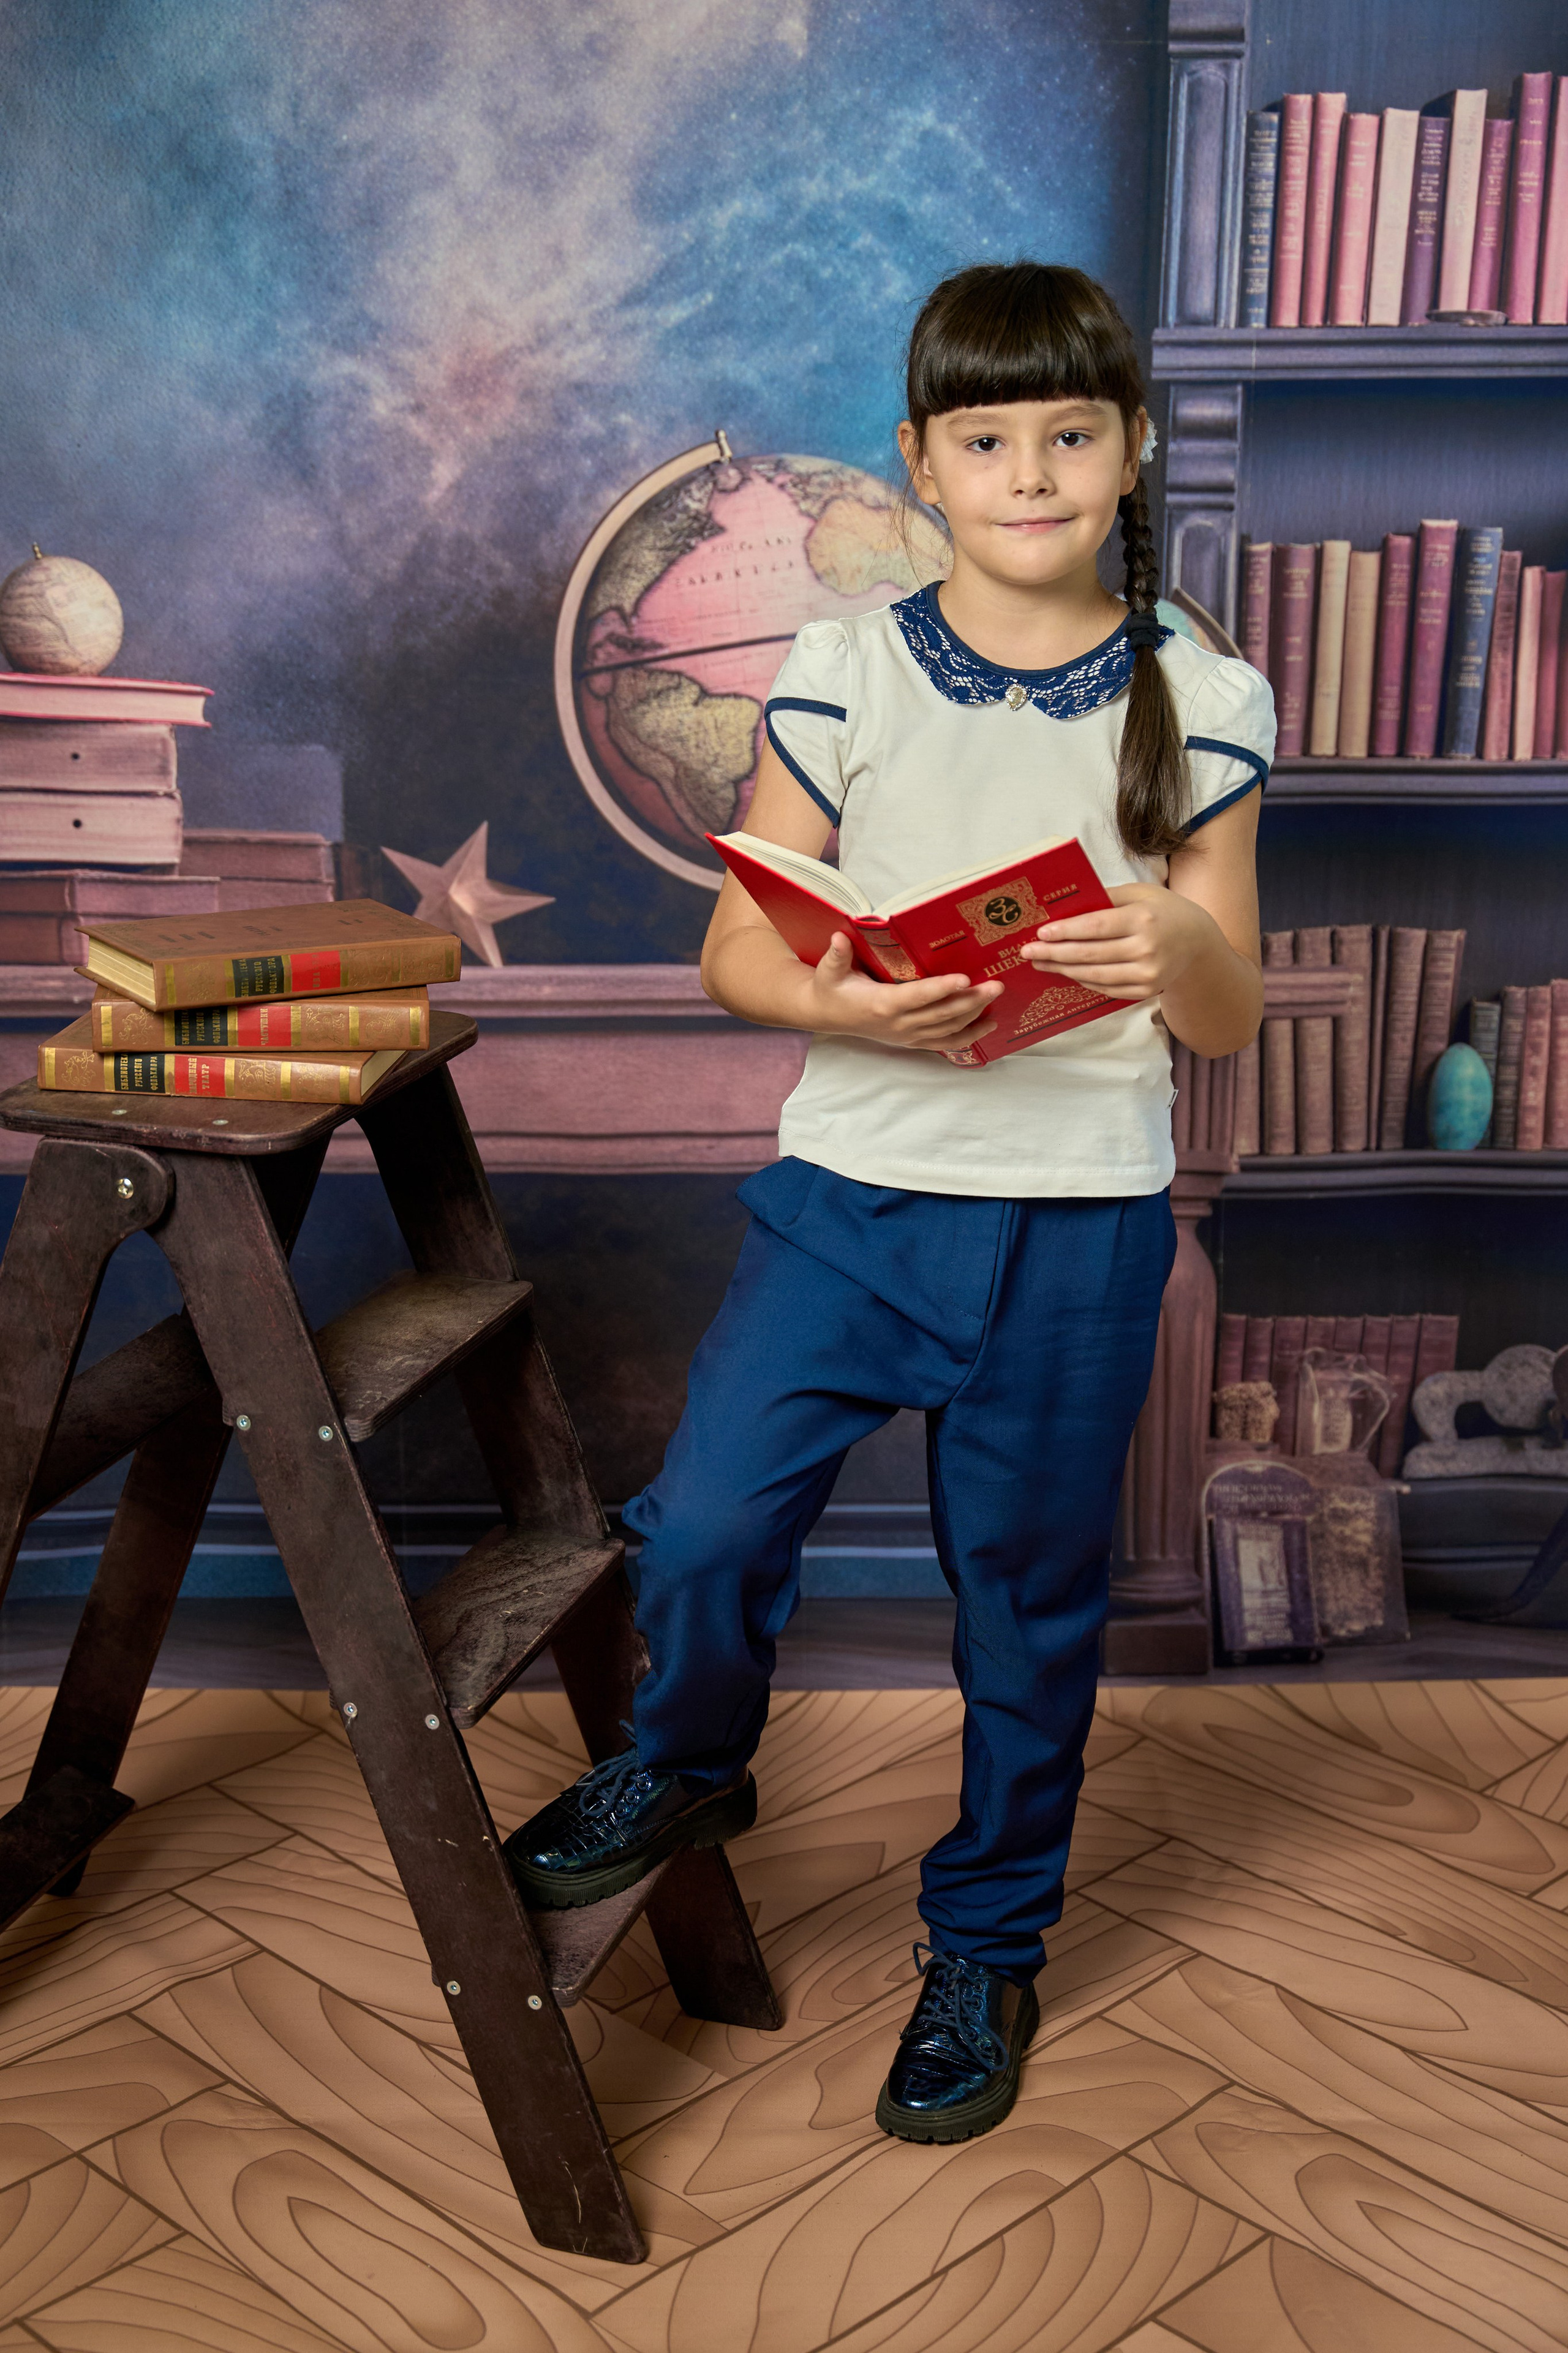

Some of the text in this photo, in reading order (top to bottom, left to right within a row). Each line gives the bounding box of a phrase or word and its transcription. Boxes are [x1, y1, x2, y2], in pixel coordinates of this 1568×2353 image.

[1042, 883, 1078, 901] СЕРИЯ
[928, 930, 965, 949] ЗОЛОТАЯ
[254, 961, 264, 992] РУССКОГО
[196, 1012, 205, 1041] РУССКОГО
[212, 1009, 221, 1044] ФОЛЬКЛОРА
[1014, 995, 1109, 1035] Зарубежная литератур
[134, 1058, 143, 1087] РУССКОГО
[150, 1056, 159, 1090] ФОЛЬКЛОРА
[188, 1057, 197, 1094] НАРОДНЫЙ
[202, 1063, 210, 1089] ТЕАТР
